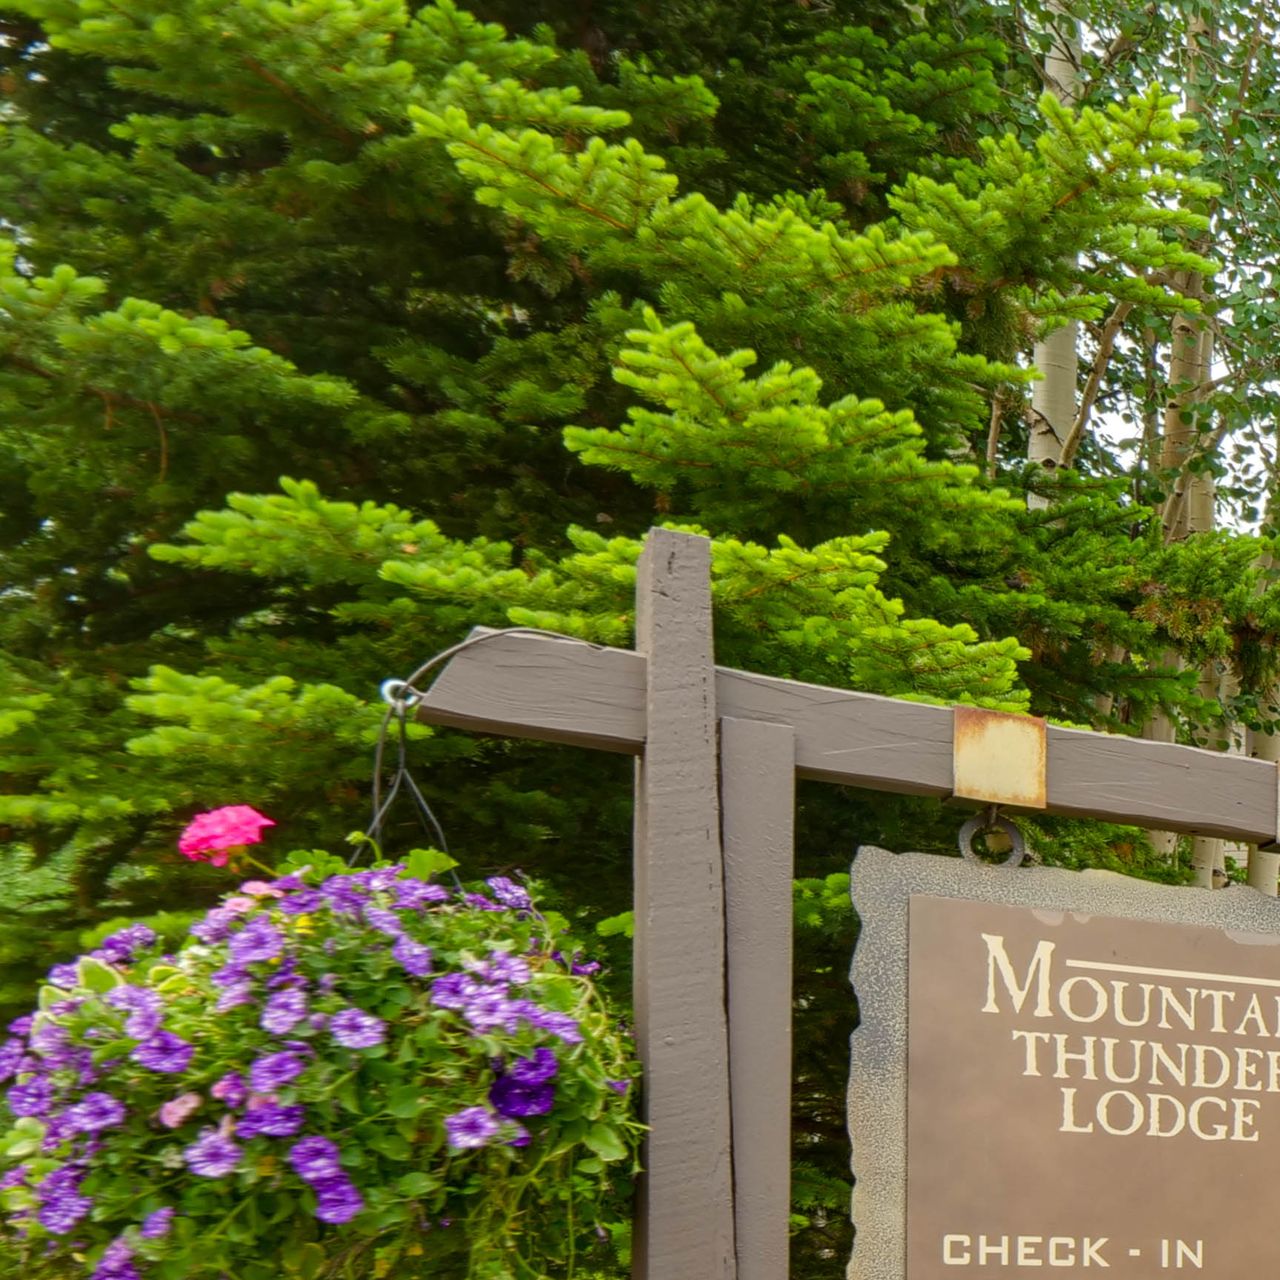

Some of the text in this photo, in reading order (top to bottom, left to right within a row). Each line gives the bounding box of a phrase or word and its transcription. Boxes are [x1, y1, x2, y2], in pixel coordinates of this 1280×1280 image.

[1058, 1087, 1261, 1142] LODGE
[942, 1234, 1110, 1268] CHECK
[1161, 1239, 1204, 1269] IN
